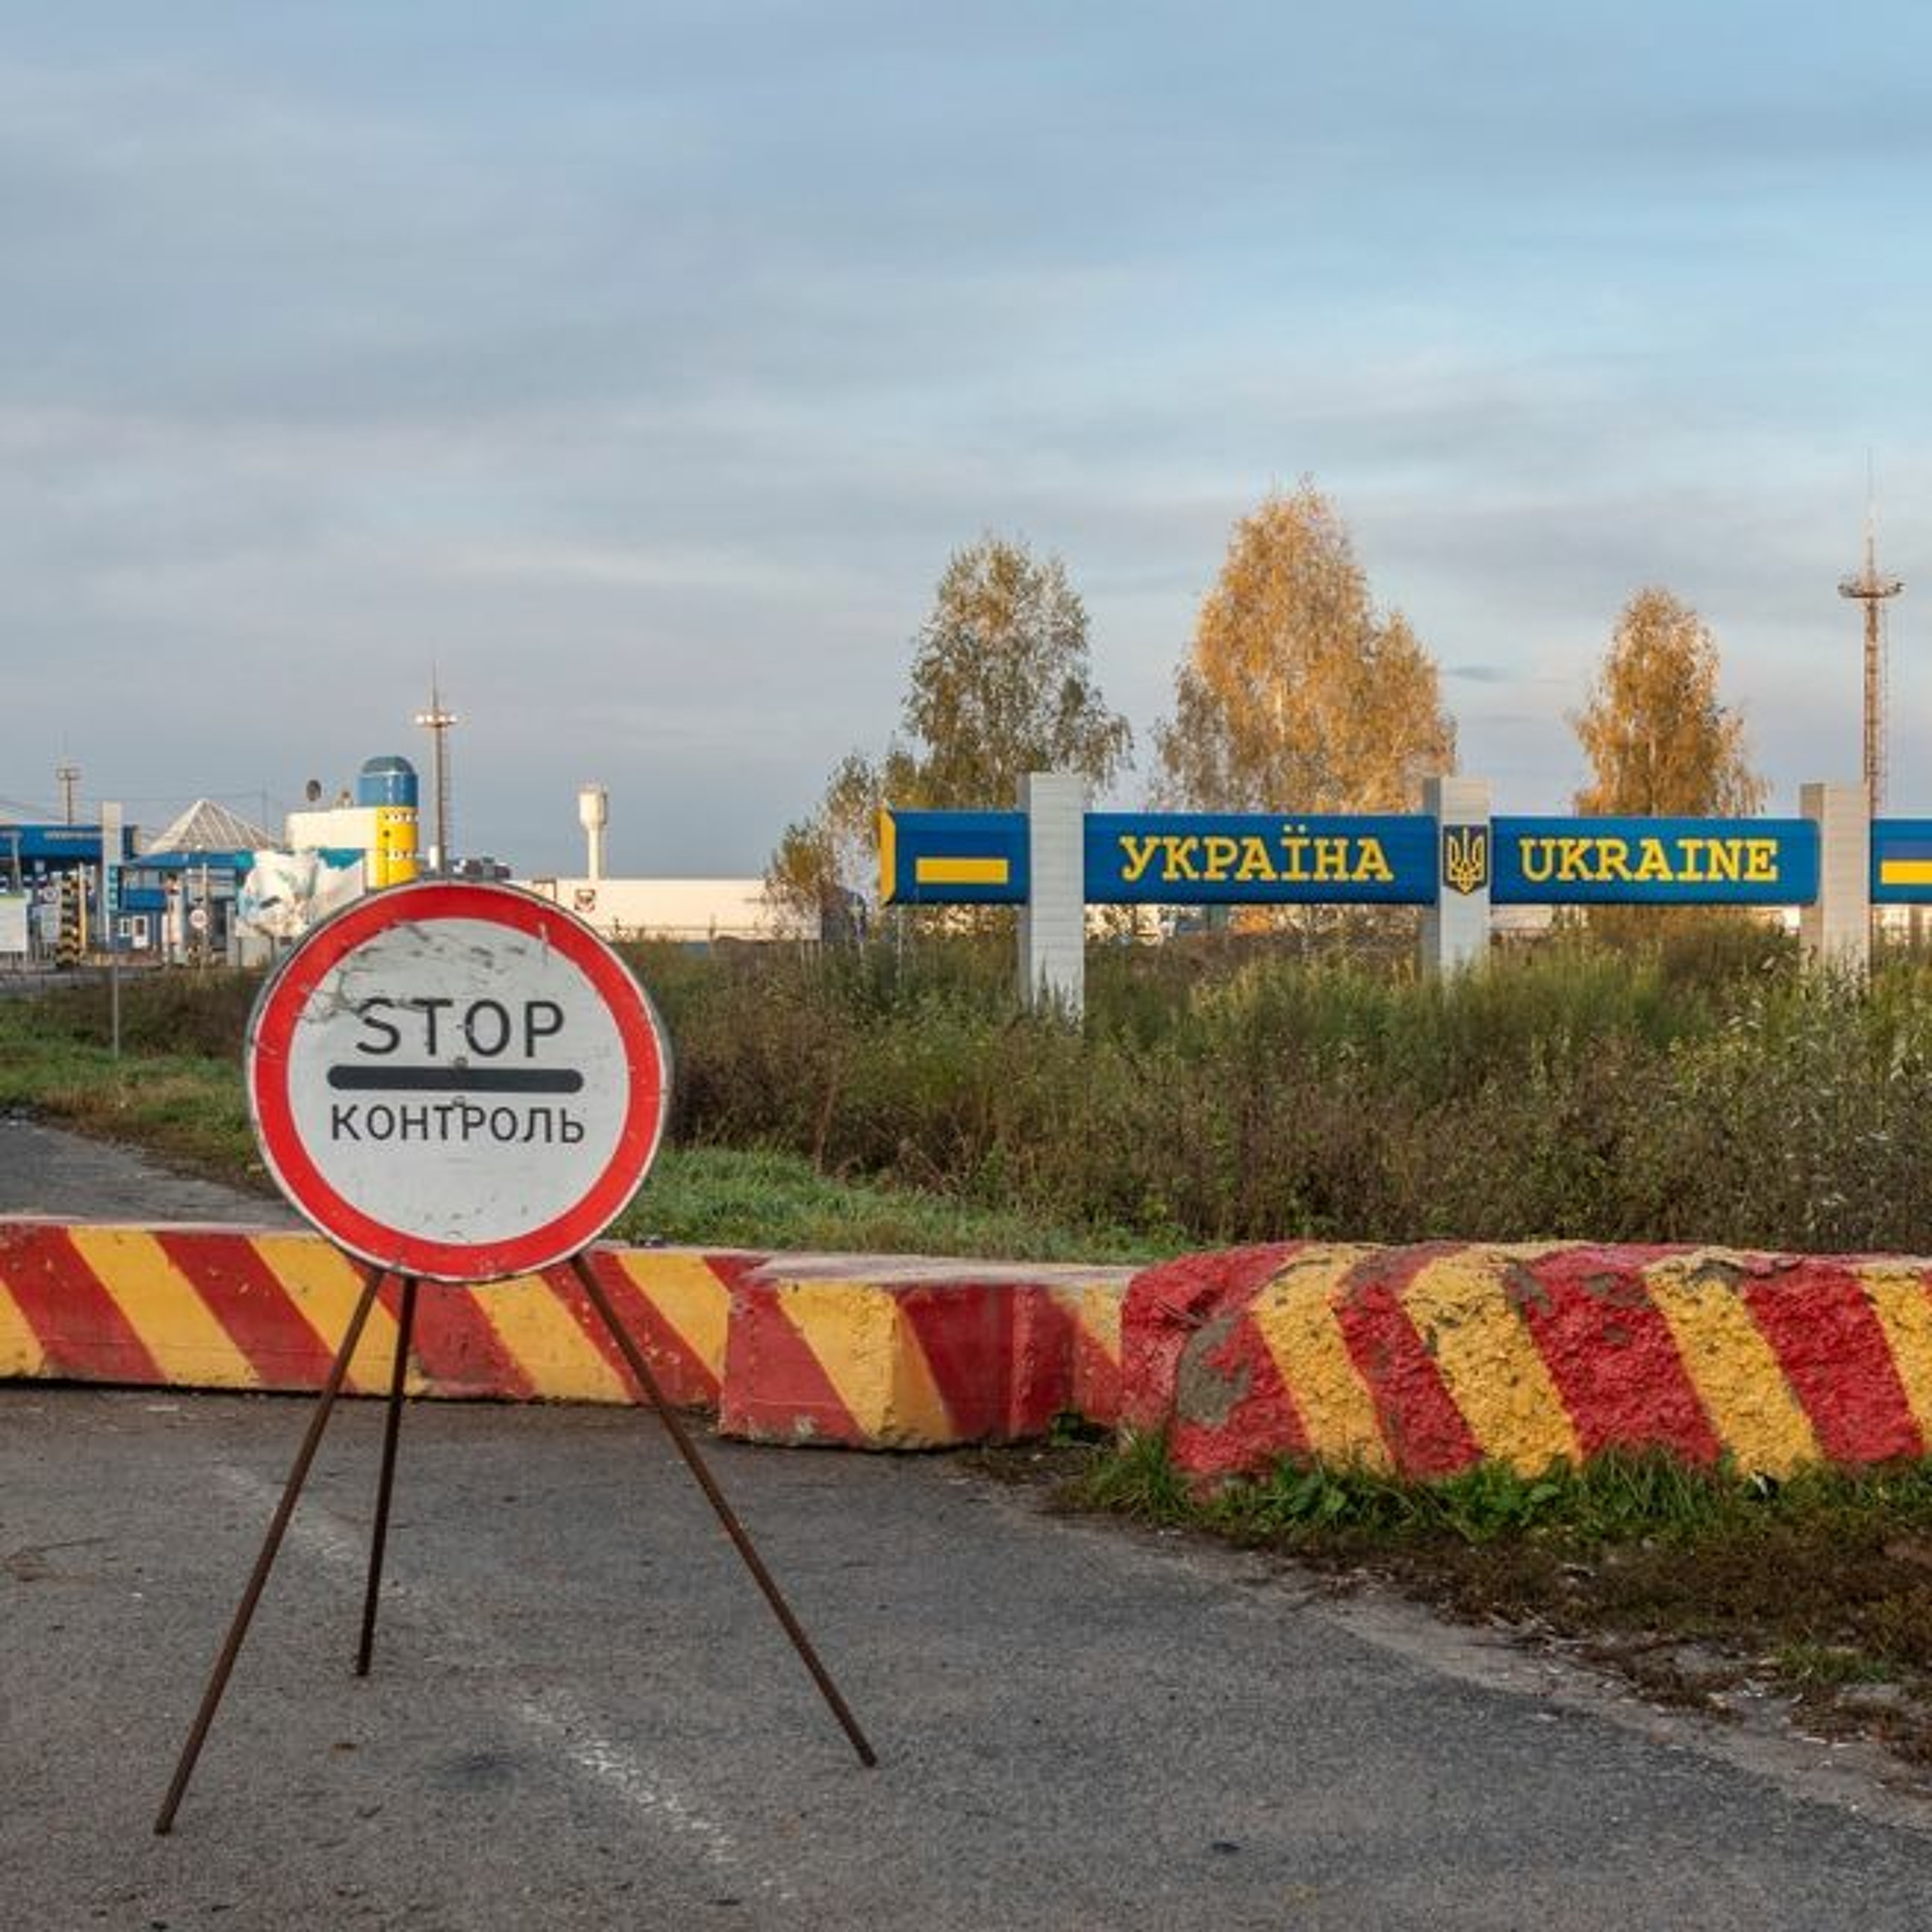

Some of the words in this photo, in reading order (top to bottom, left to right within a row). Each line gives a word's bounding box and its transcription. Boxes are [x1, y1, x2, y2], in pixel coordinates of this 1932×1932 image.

[1119, 824, 1393, 882] УКРАЇНА
[1519, 838, 1778, 882] UKRAINE
[356, 998, 564, 1057] STOP
[330, 1104, 585, 1144] КОНТРОЛЬ
